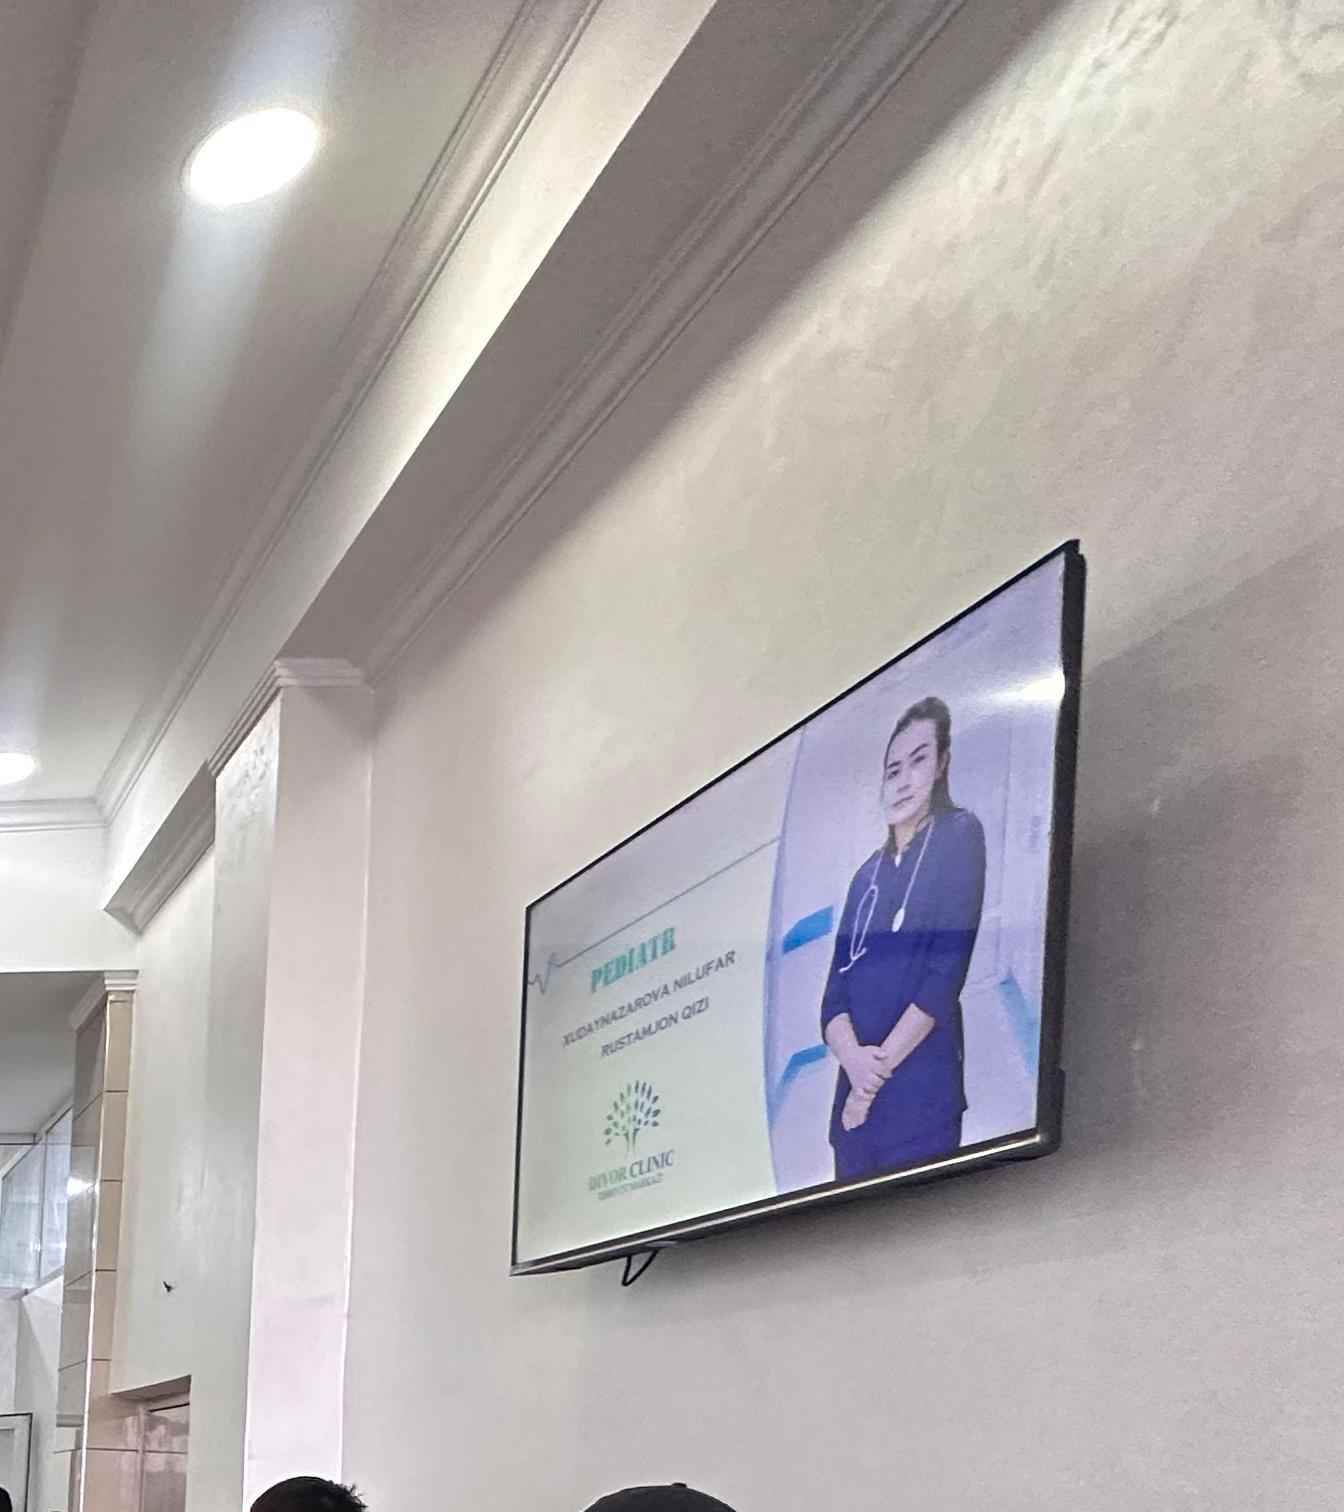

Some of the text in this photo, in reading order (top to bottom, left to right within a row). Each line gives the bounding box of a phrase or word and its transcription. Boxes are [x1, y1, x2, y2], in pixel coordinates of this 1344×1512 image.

[591, 927, 675, 993] PEDIATR
[673, 950, 736, 992] NILUFAR
[601, 997, 709, 1057] RUSTAMJON QIZI
[630, 1150, 675, 1178] CLINIC
